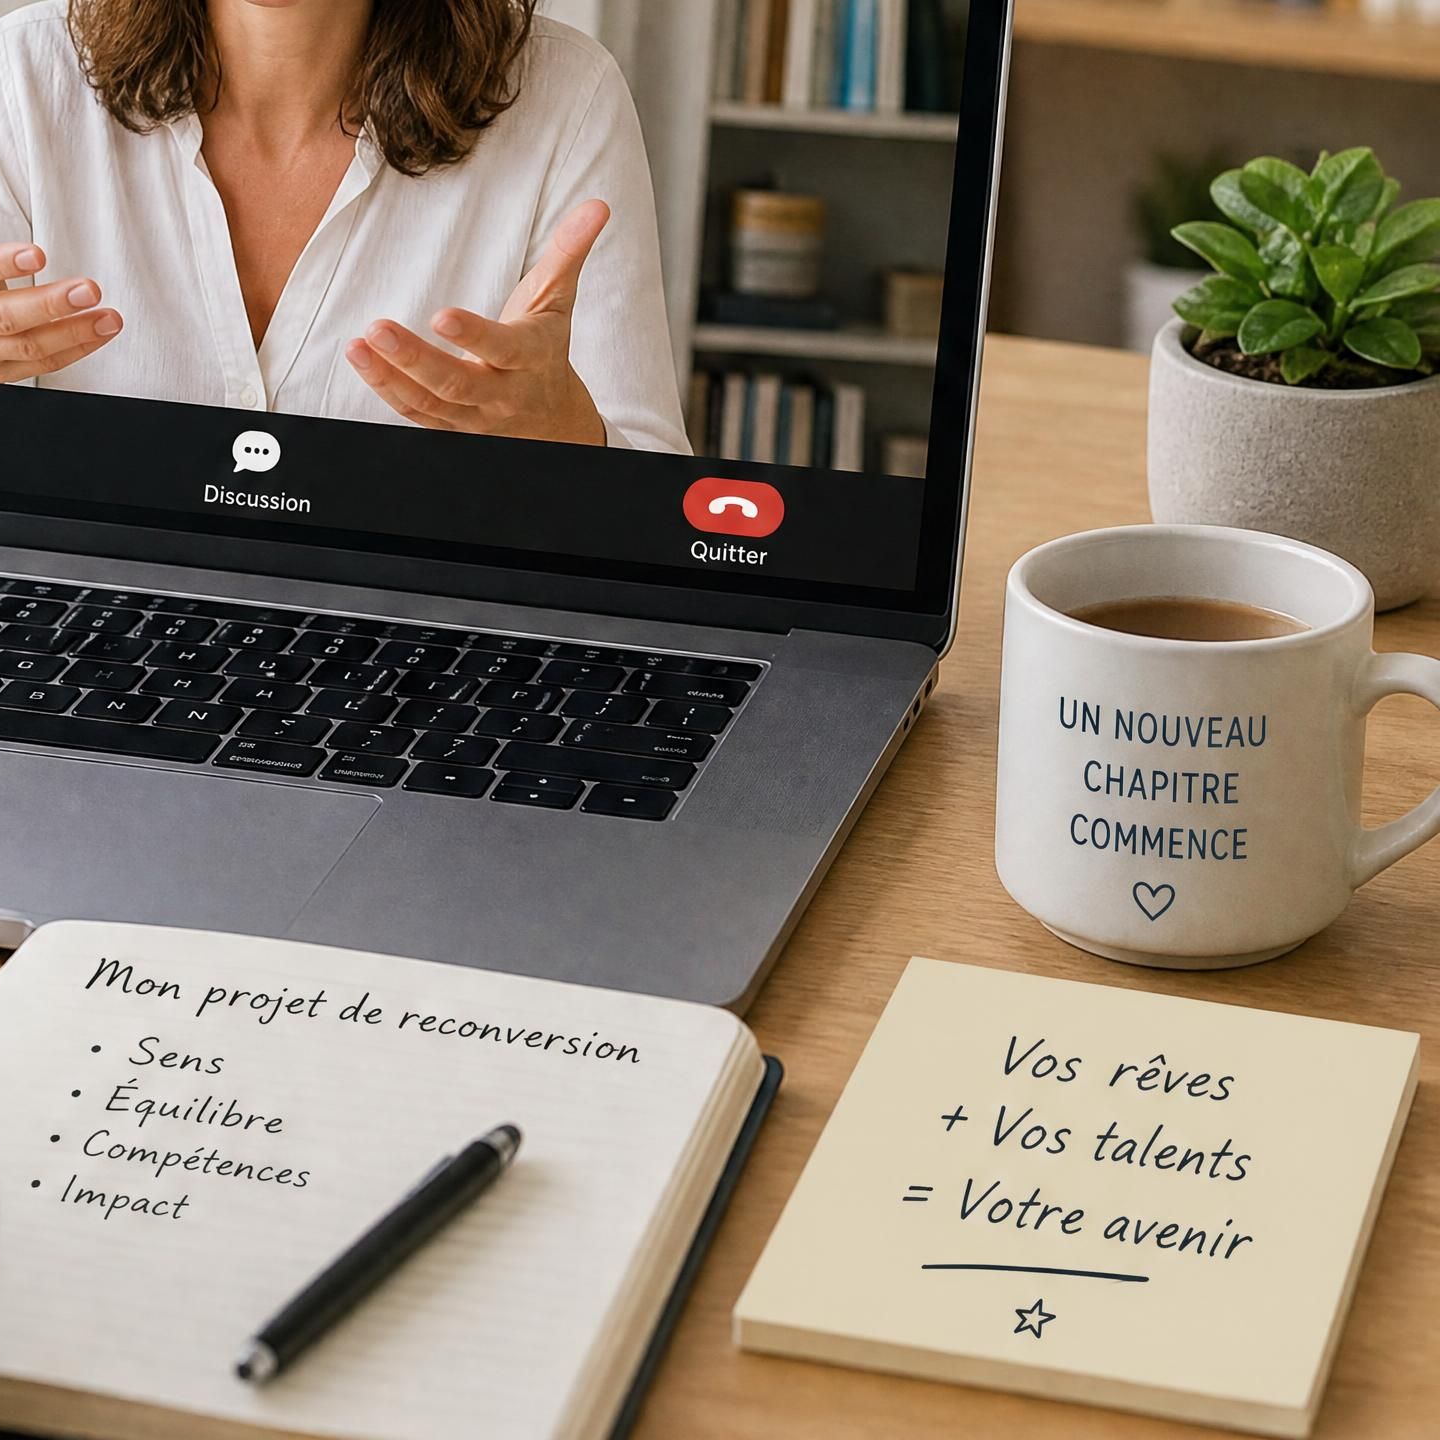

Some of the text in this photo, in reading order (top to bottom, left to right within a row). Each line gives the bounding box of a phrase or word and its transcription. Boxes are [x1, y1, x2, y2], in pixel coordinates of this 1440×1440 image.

[204, 484, 311, 513] Discussion
[690, 540, 768, 565] Quitter
[1059, 696, 1267, 749] UN NOUVEAU
[1083, 760, 1240, 805] CHAPITRE
[1070, 813, 1249, 861] COMMENCE
[84, 957, 641, 1064] Mon projet de reconversion
[128, 1036, 225, 1075] Sens
[1004, 1035, 1235, 1101] Vos rêves
[105, 1077, 284, 1135] Équilibre
[83, 1129, 311, 1189] Compétences
[993, 1105, 1072, 1155] Vos
[1093, 1121, 1252, 1181] talents
[60, 1174, 190, 1221] Impact
[960, 1177, 1085, 1235] Votre
[1103, 1215, 1254, 1260] avenir
